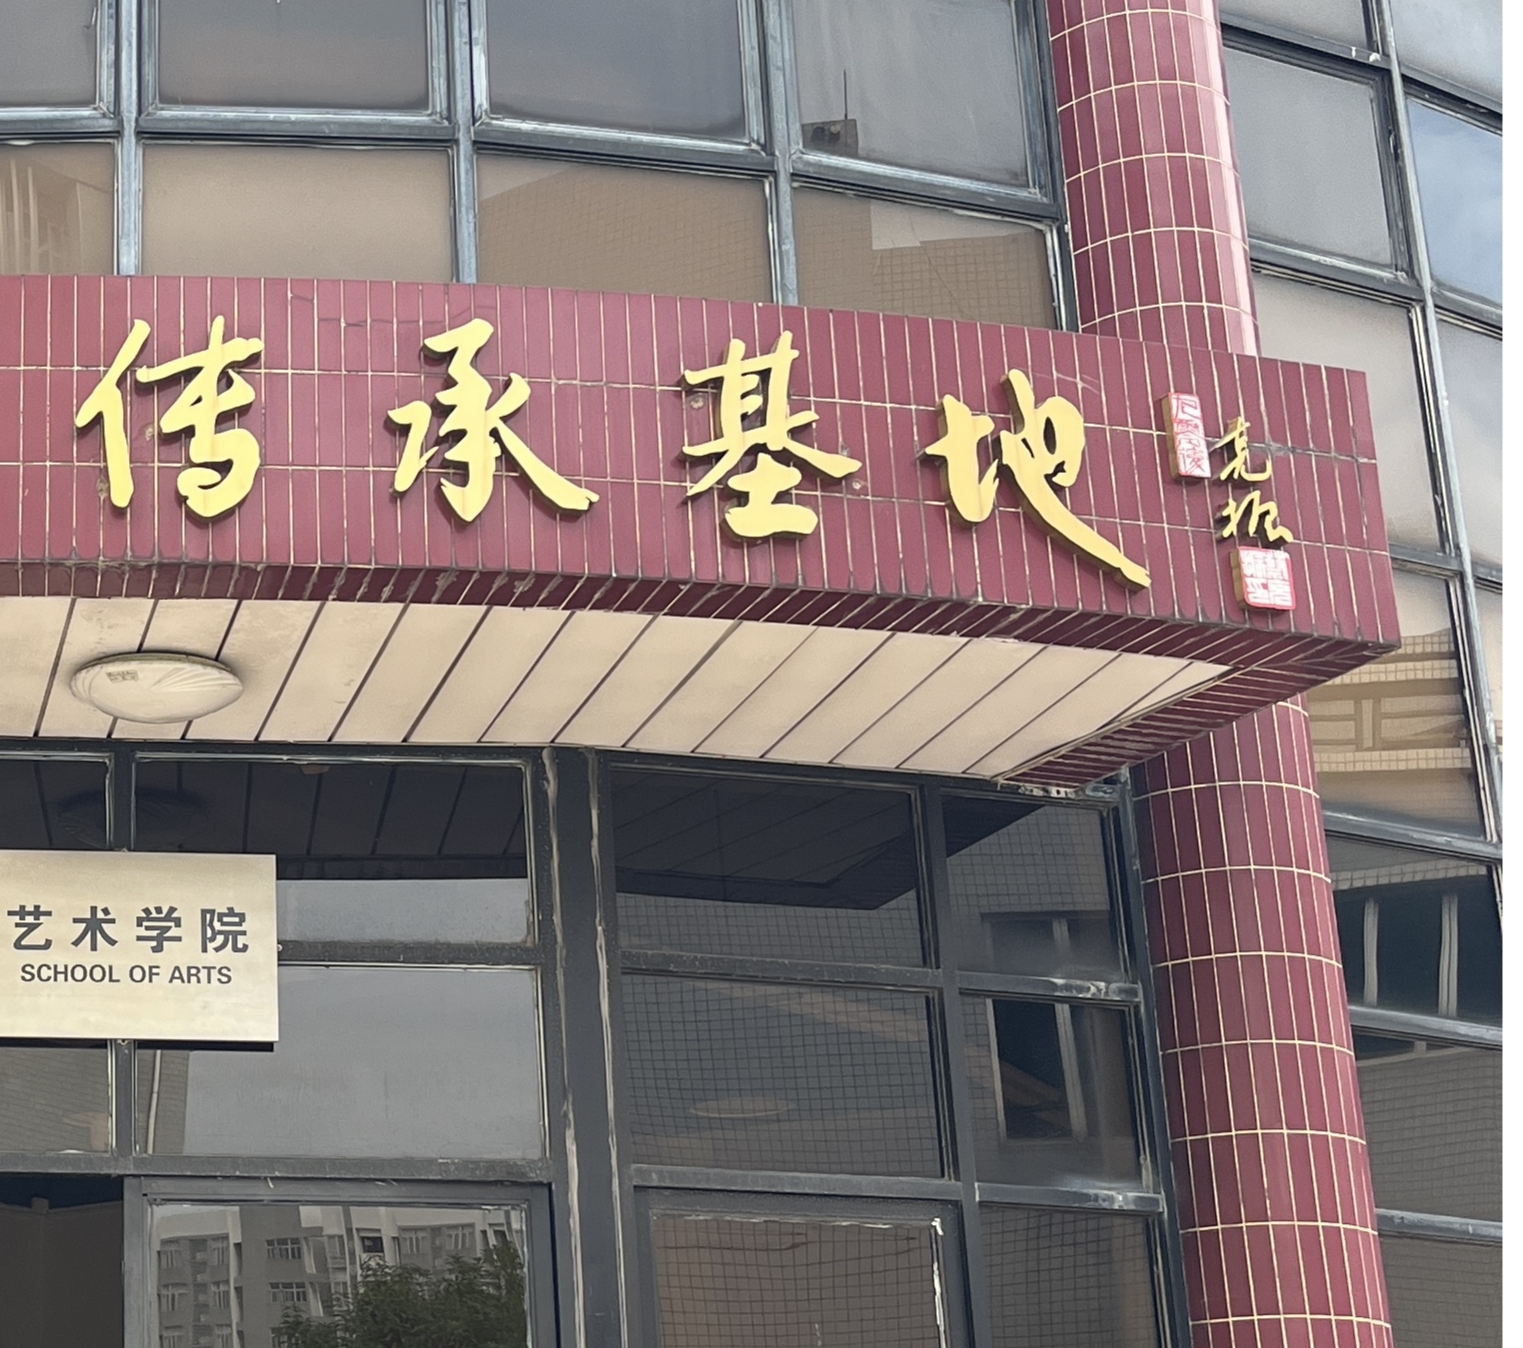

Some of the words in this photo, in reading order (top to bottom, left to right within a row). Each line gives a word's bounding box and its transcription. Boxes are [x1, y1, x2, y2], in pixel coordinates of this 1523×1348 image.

[7, 904, 250, 954] 艺术学院
[20, 963, 121, 983] SCHOOL
[128, 964, 161, 984] OF
[168, 965, 233, 984] ARTS
